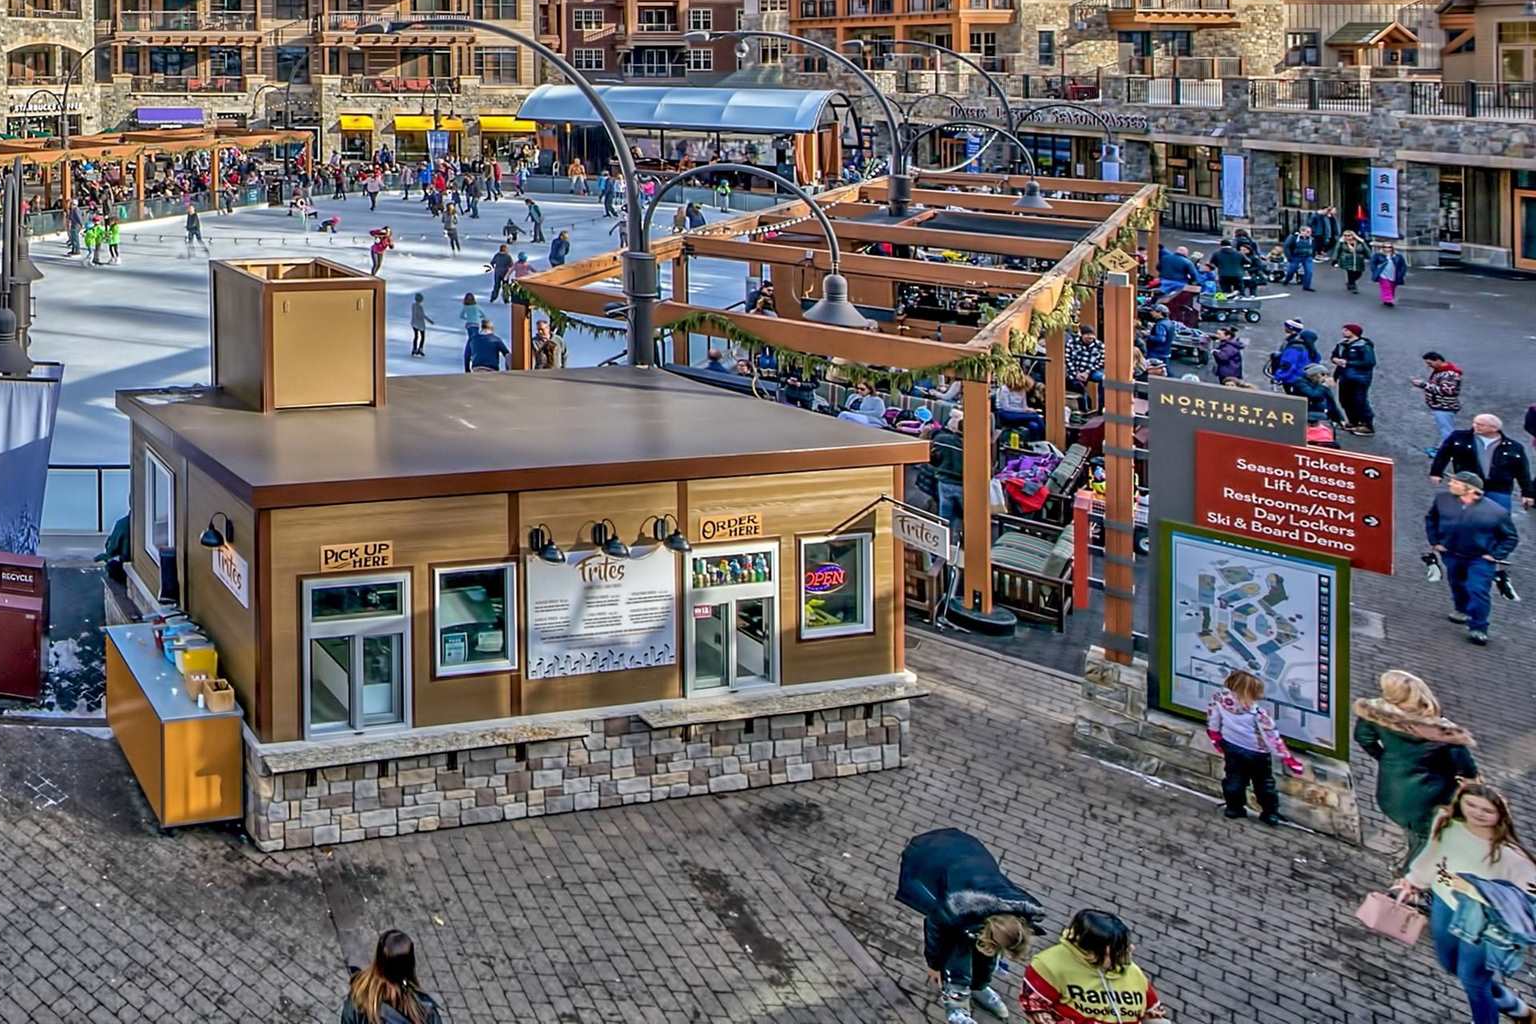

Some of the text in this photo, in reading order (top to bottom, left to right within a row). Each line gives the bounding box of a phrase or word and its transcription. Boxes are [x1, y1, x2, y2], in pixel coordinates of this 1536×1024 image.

[1159, 393, 1295, 426] NORTHSTAR
[1180, 407, 1275, 428] CALIFORNIA
[1236, 457, 1356, 490] Season Passes
[1294, 453, 1356, 475] Tickets
[1223, 486, 1355, 523] Restrooms/ATM
[1264, 477, 1356, 505] Lift Access
[701, 513, 758, 540] ORDER
[729, 524, 760, 538] HERE
[895, 514, 941, 548] Frites
[1207, 511, 1231, 527] Ski
[1233, 517, 1248, 530] &
[1251, 520, 1300, 541] Board
[1304, 529, 1356, 553] Demo
[1254, 506, 1356, 538] Day Lockers
[324, 543, 390, 566] PICK UP
[352, 555, 390, 569] HERE
[574, 553, 625, 583] Frites
[1, 572, 34, 583] RECYCLE
[805, 568, 846, 587] OPEN
[1066, 984, 1143, 1006] Ramen
